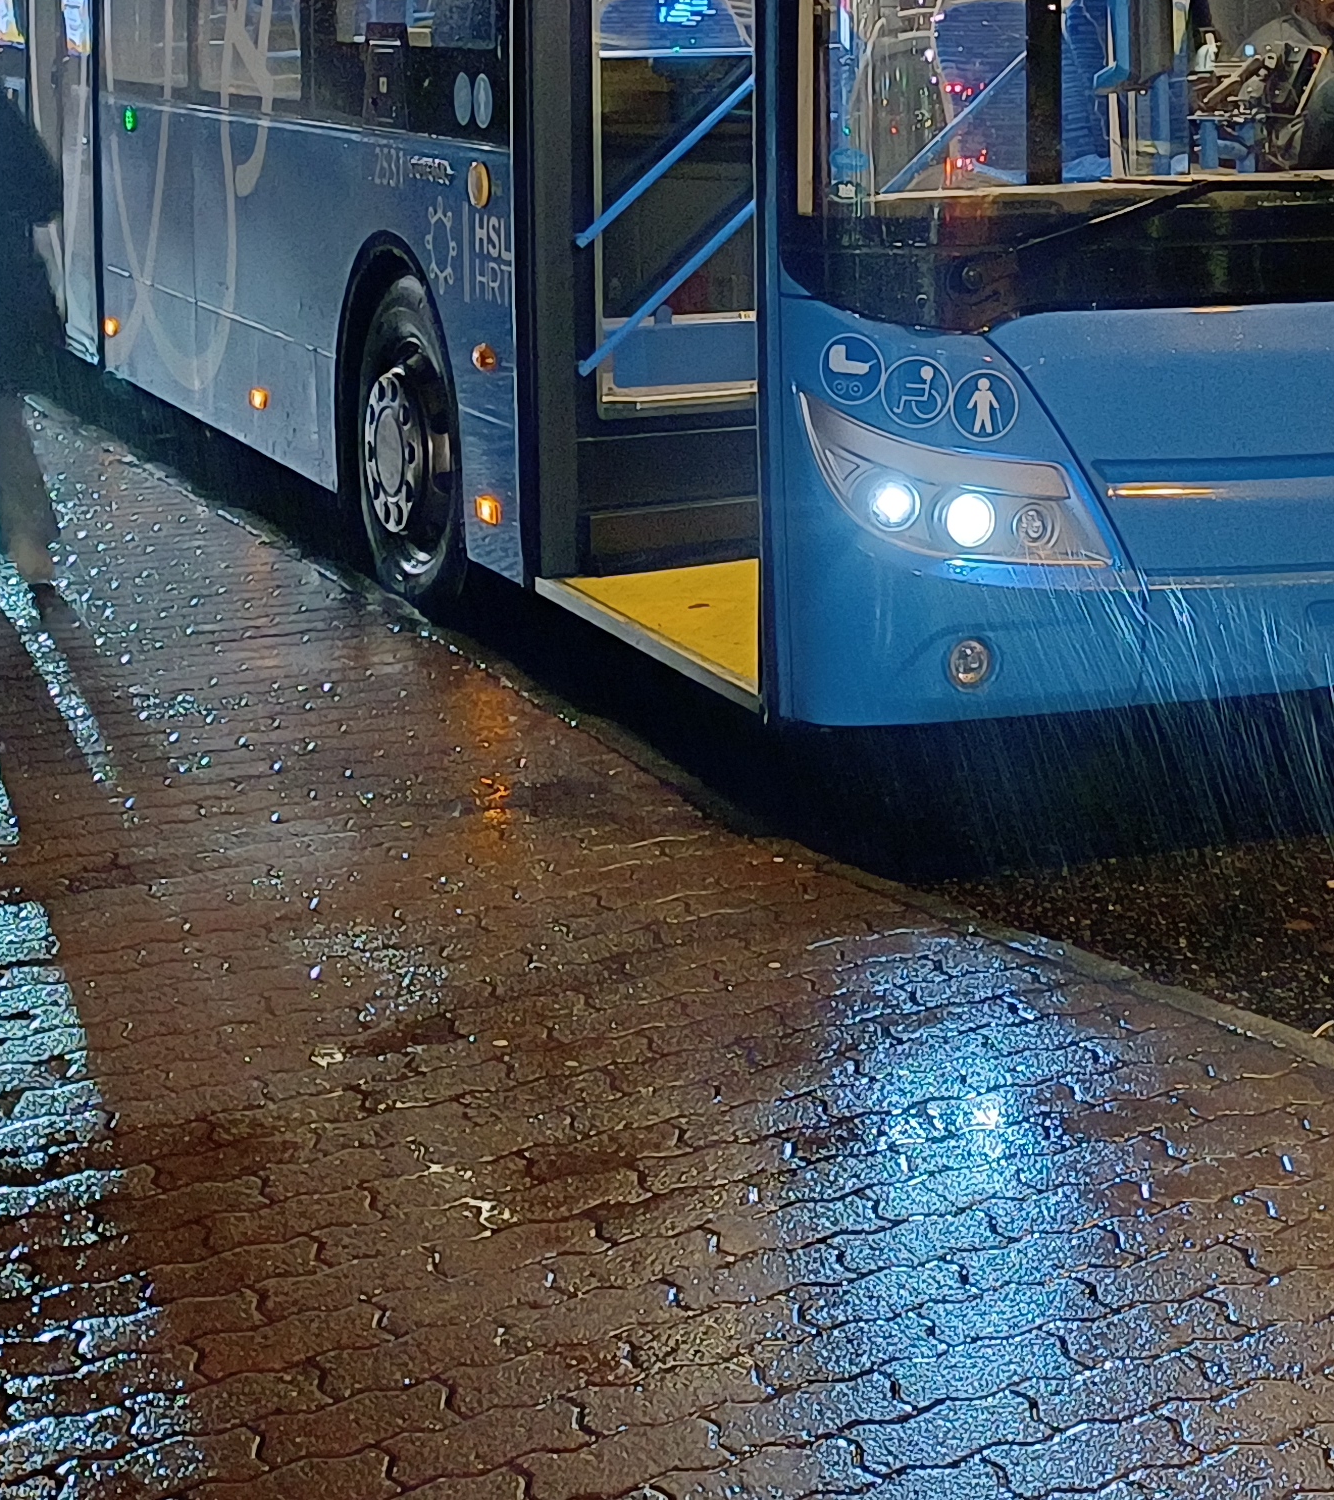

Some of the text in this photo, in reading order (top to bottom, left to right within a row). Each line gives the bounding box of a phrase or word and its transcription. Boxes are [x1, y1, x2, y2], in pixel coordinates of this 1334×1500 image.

[374, 146, 404, 190] 2531
[474, 212, 512, 262] HSL
[474, 257, 512, 308] HRT
